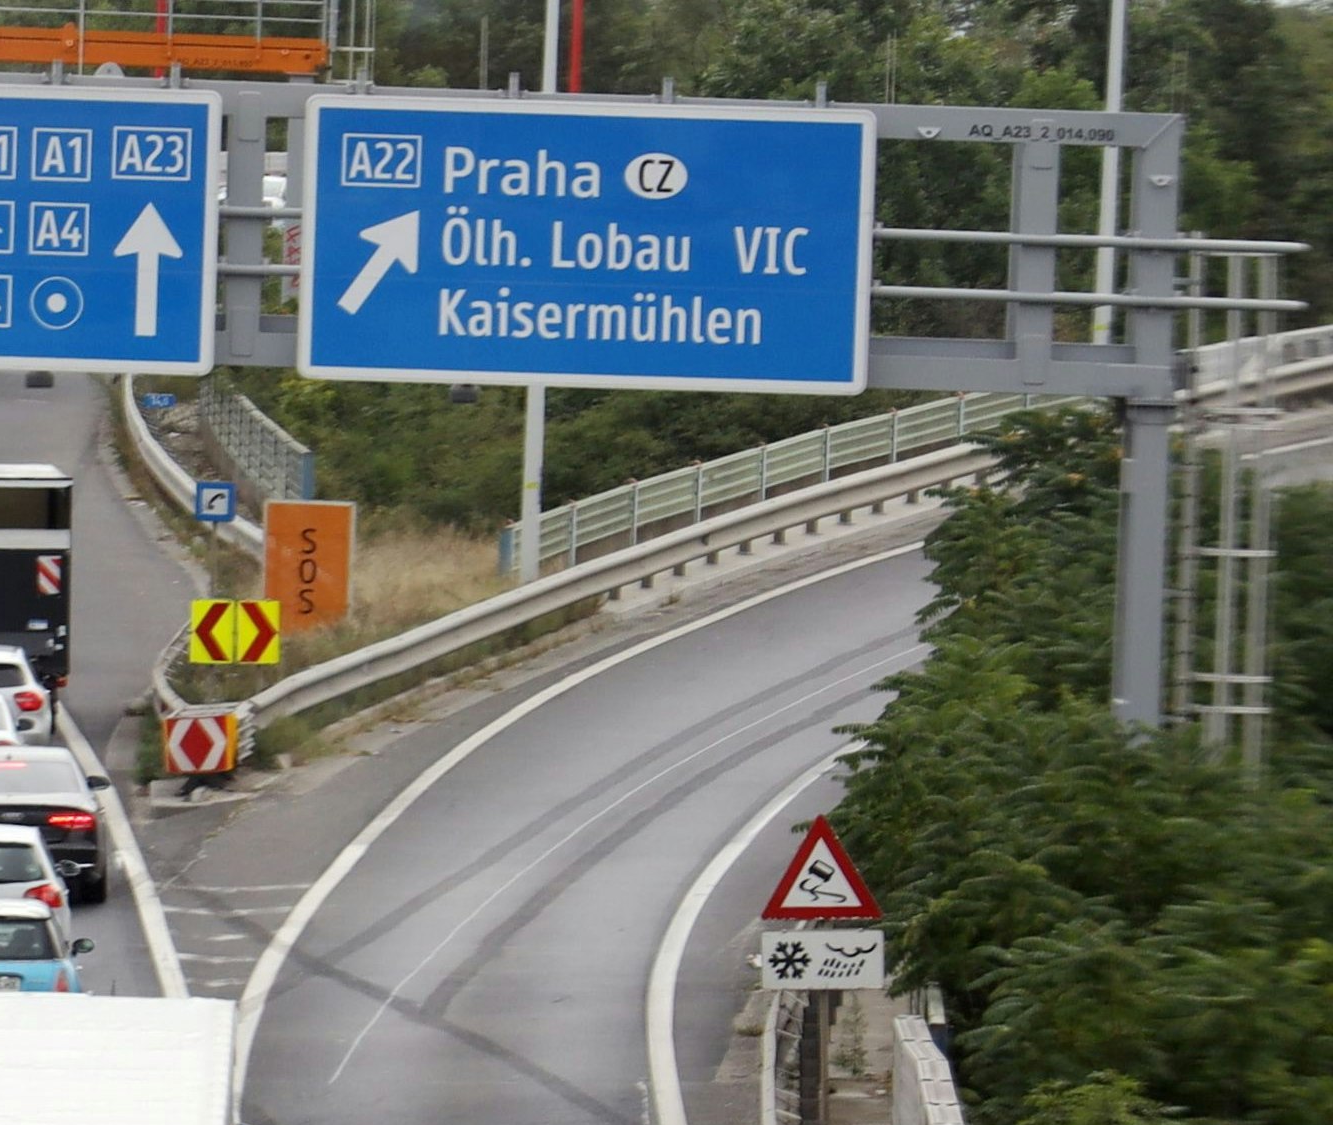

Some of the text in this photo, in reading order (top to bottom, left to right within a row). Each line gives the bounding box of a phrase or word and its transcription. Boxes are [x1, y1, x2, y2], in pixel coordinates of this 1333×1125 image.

[41, 135, 83, 174] A1
[119, 134, 184, 174] A23
[348, 140, 676, 199] A22 Praha CZ
[35, 209, 83, 248] A4
[441, 206, 809, 275] Ölh. Lobau VIC
[437, 287, 763, 346] Kaisermühlen
[298, 527, 319, 616] SOS
